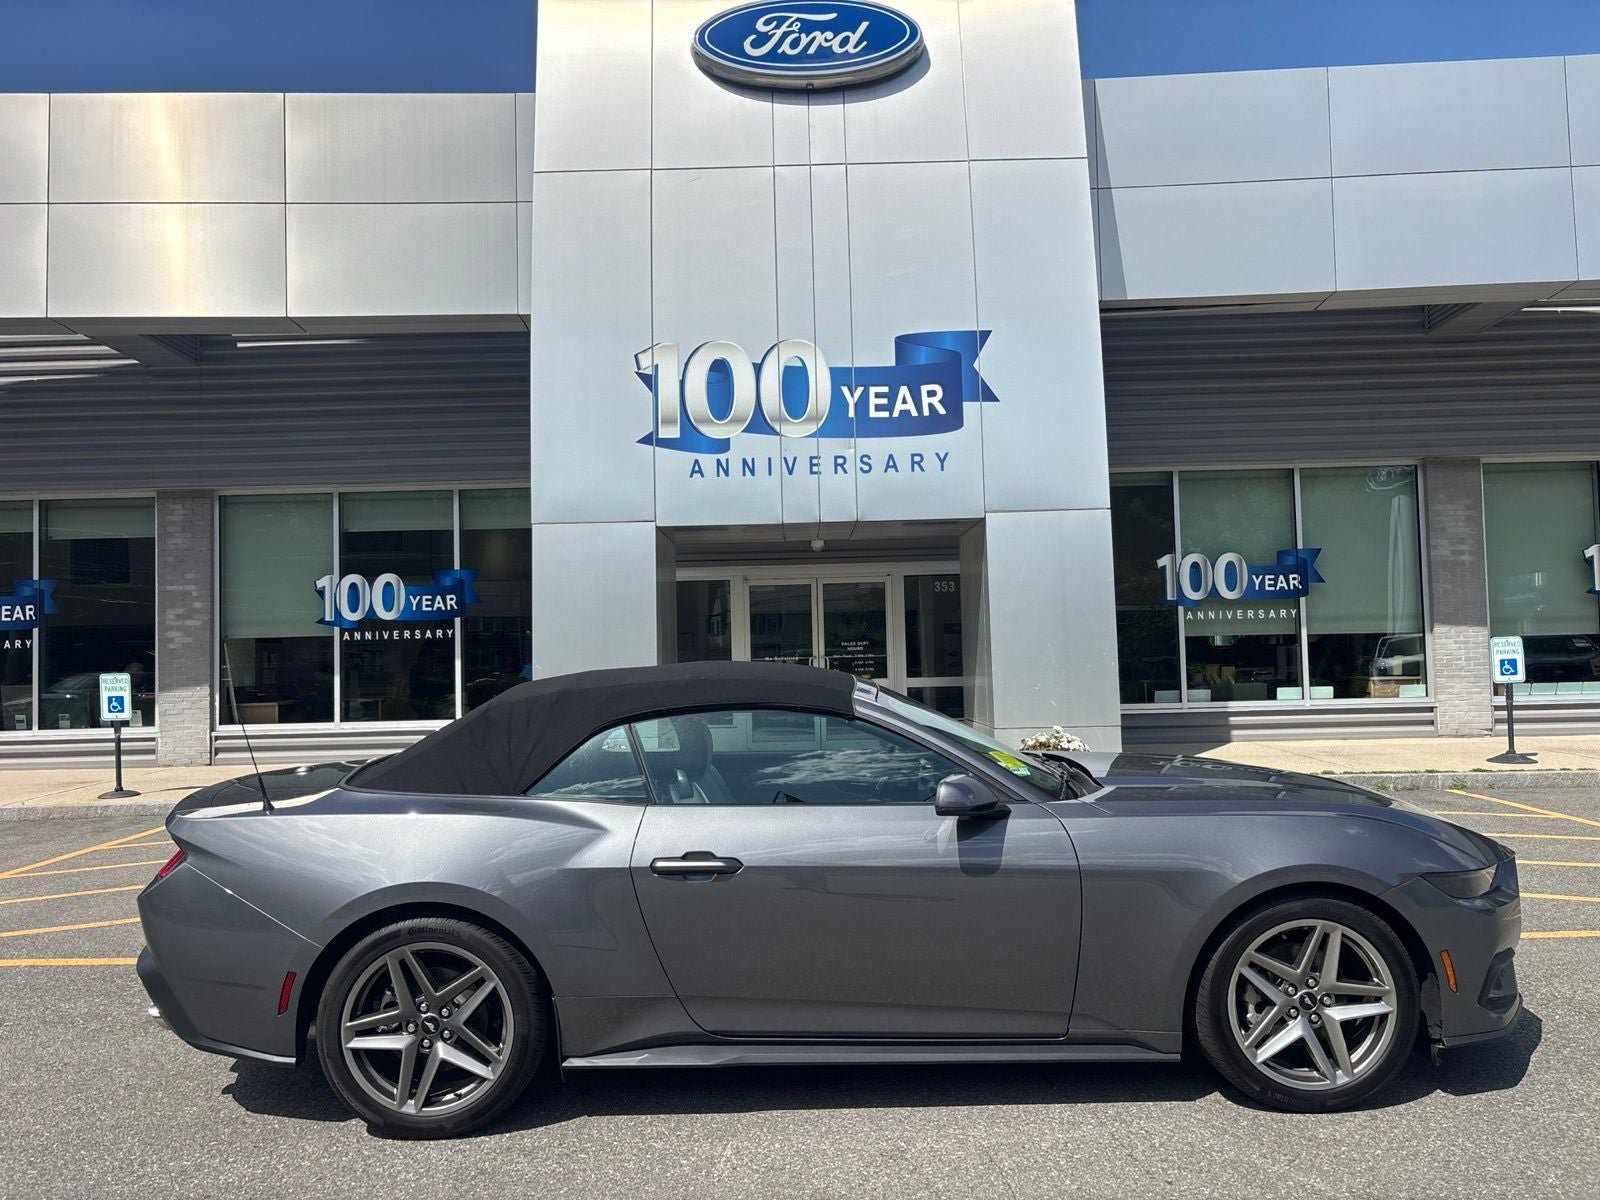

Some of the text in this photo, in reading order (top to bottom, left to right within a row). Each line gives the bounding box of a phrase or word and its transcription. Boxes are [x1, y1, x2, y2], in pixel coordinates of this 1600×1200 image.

[743, 12, 870, 56] Ford
[634, 340, 947, 439] 100 YEAR
[689, 451, 951, 479] ANNIVERSARY
[934, 581, 955, 592] 353
[1156, 552, 1302, 600] 100 YEAR
[314, 573, 458, 621] 100 YEAR
[1186, 608, 1297, 620] ANNIVERSARY
[343, 629, 454, 641] ANNIVERSARY
